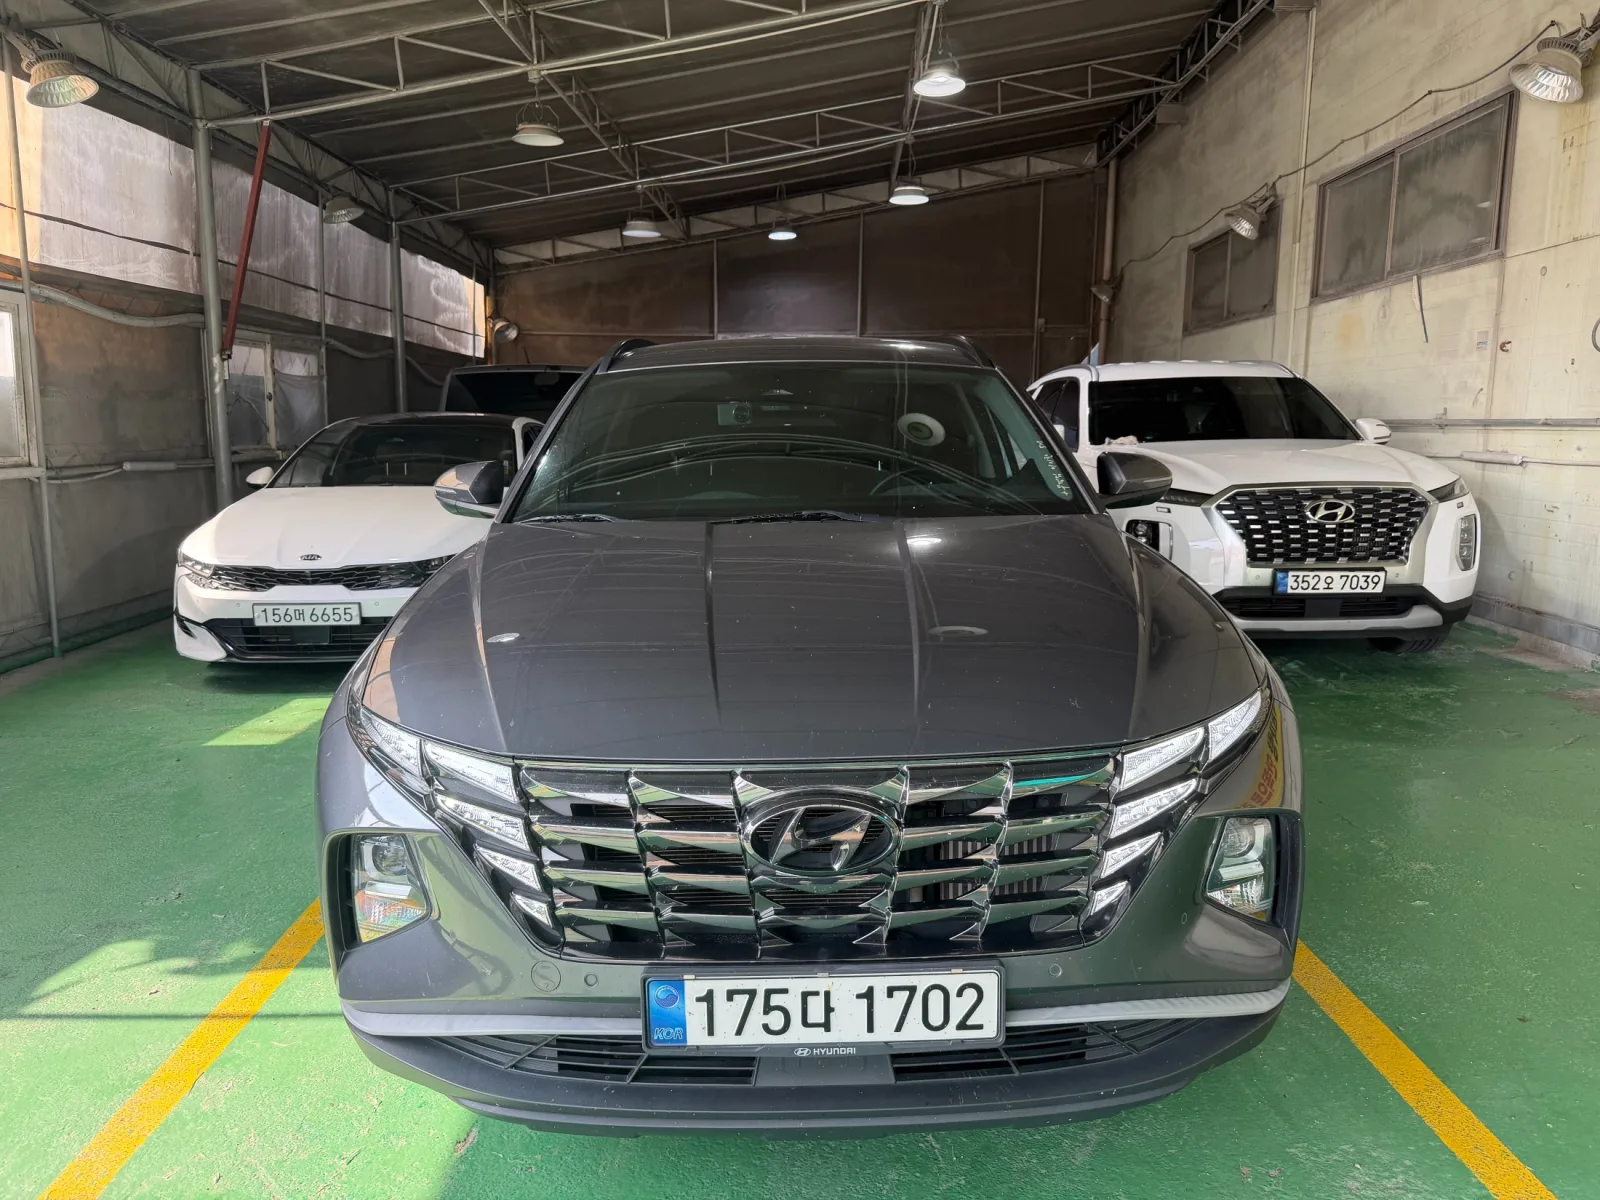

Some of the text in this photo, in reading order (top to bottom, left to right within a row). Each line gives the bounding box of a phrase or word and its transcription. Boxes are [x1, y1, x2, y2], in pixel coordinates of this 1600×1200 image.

[1289, 574, 1334, 591] 352오
[1339, 574, 1381, 591] 7039
[261, 607, 353, 623] 156머 6655
[695, 982, 985, 1038] 175다 1702
[653, 1027, 684, 1040] KOR
[813, 1047, 856, 1056] HYUNDAI
